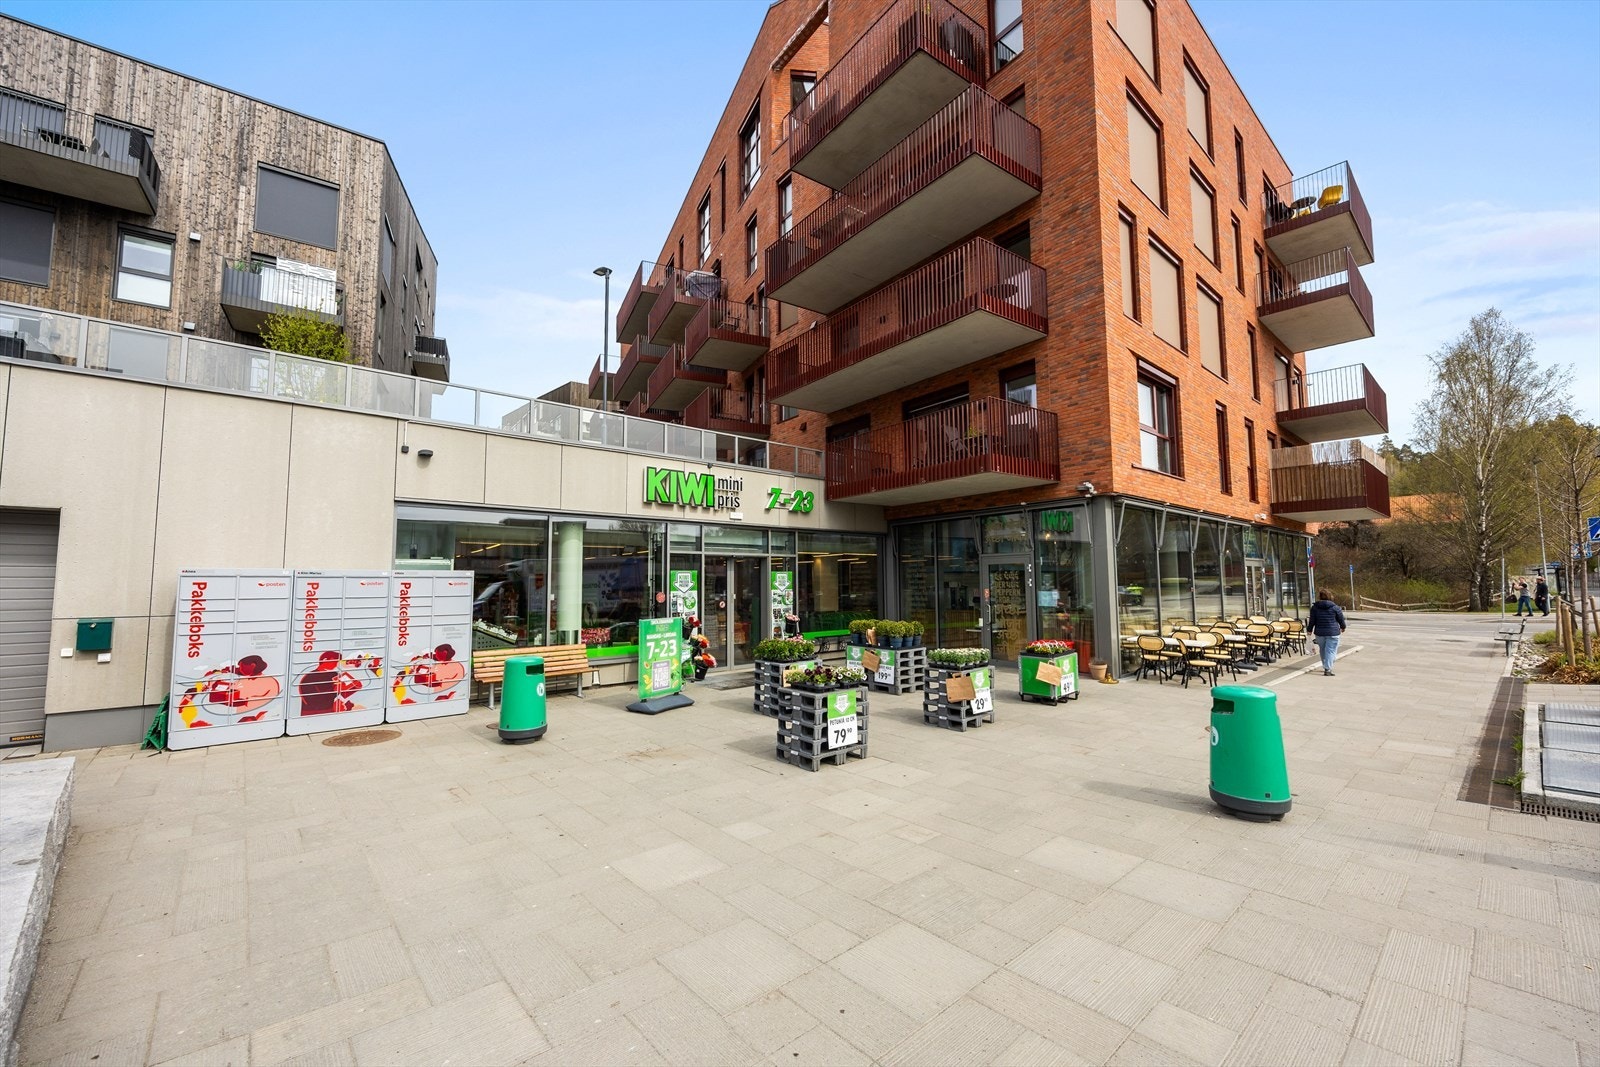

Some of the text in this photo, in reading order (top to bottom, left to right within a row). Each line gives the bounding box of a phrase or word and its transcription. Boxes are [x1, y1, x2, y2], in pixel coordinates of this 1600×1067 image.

[646, 466, 715, 508] KIWI
[717, 476, 743, 492] mini
[717, 494, 741, 509] pris
[766, 487, 815, 513] 7-23
[187, 581, 208, 659] Pakkeboks
[303, 582, 320, 652] Pakkeboks
[398, 582, 412, 647] Pakkeboks
[646, 640, 677, 659] 7-23
[975, 698, 985, 710] 29
[833, 728, 847, 744] 79
